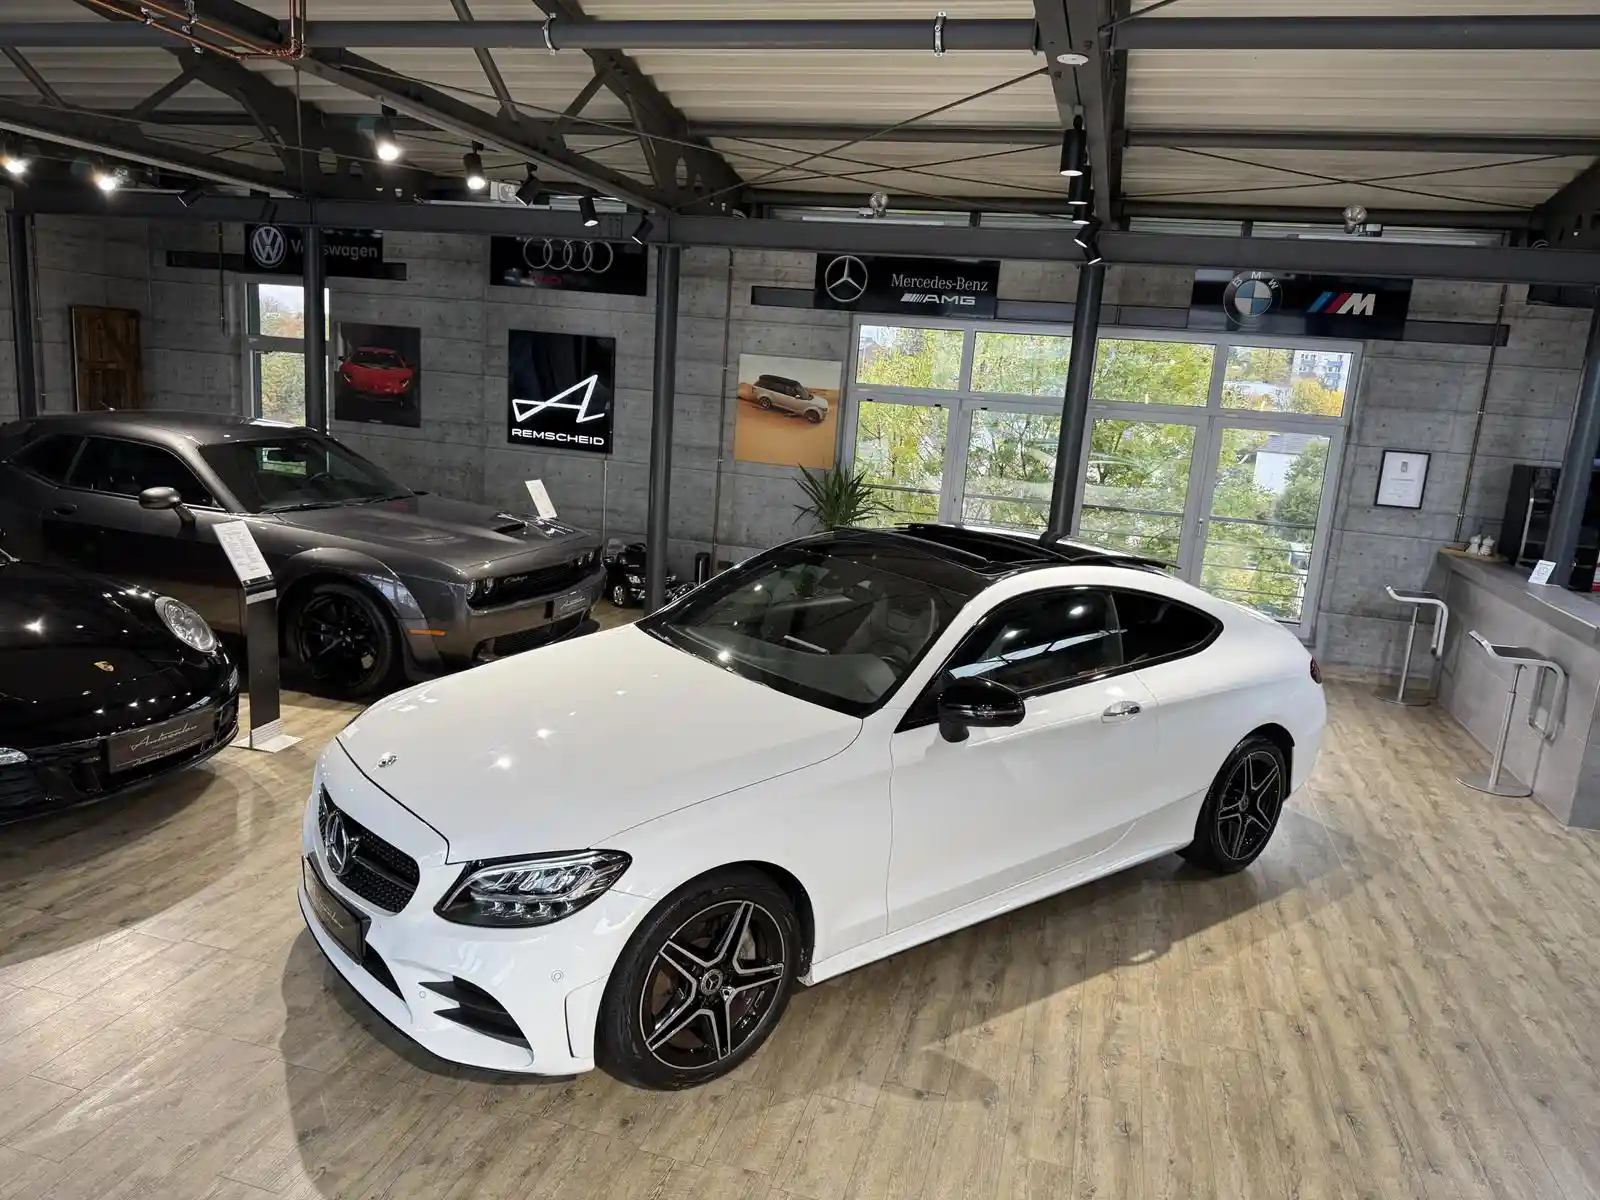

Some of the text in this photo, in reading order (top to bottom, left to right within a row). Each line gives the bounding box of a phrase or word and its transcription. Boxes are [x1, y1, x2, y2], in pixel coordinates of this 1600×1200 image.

[290, 239, 378, 261] Vswagen
[890, 273, 989, 292] Mercedes-Benz
[1232, 270, 1279, 291] BMW
[922, 294, 976, 306] AMG
[511, 428, 605, 446] REMSCHEID
